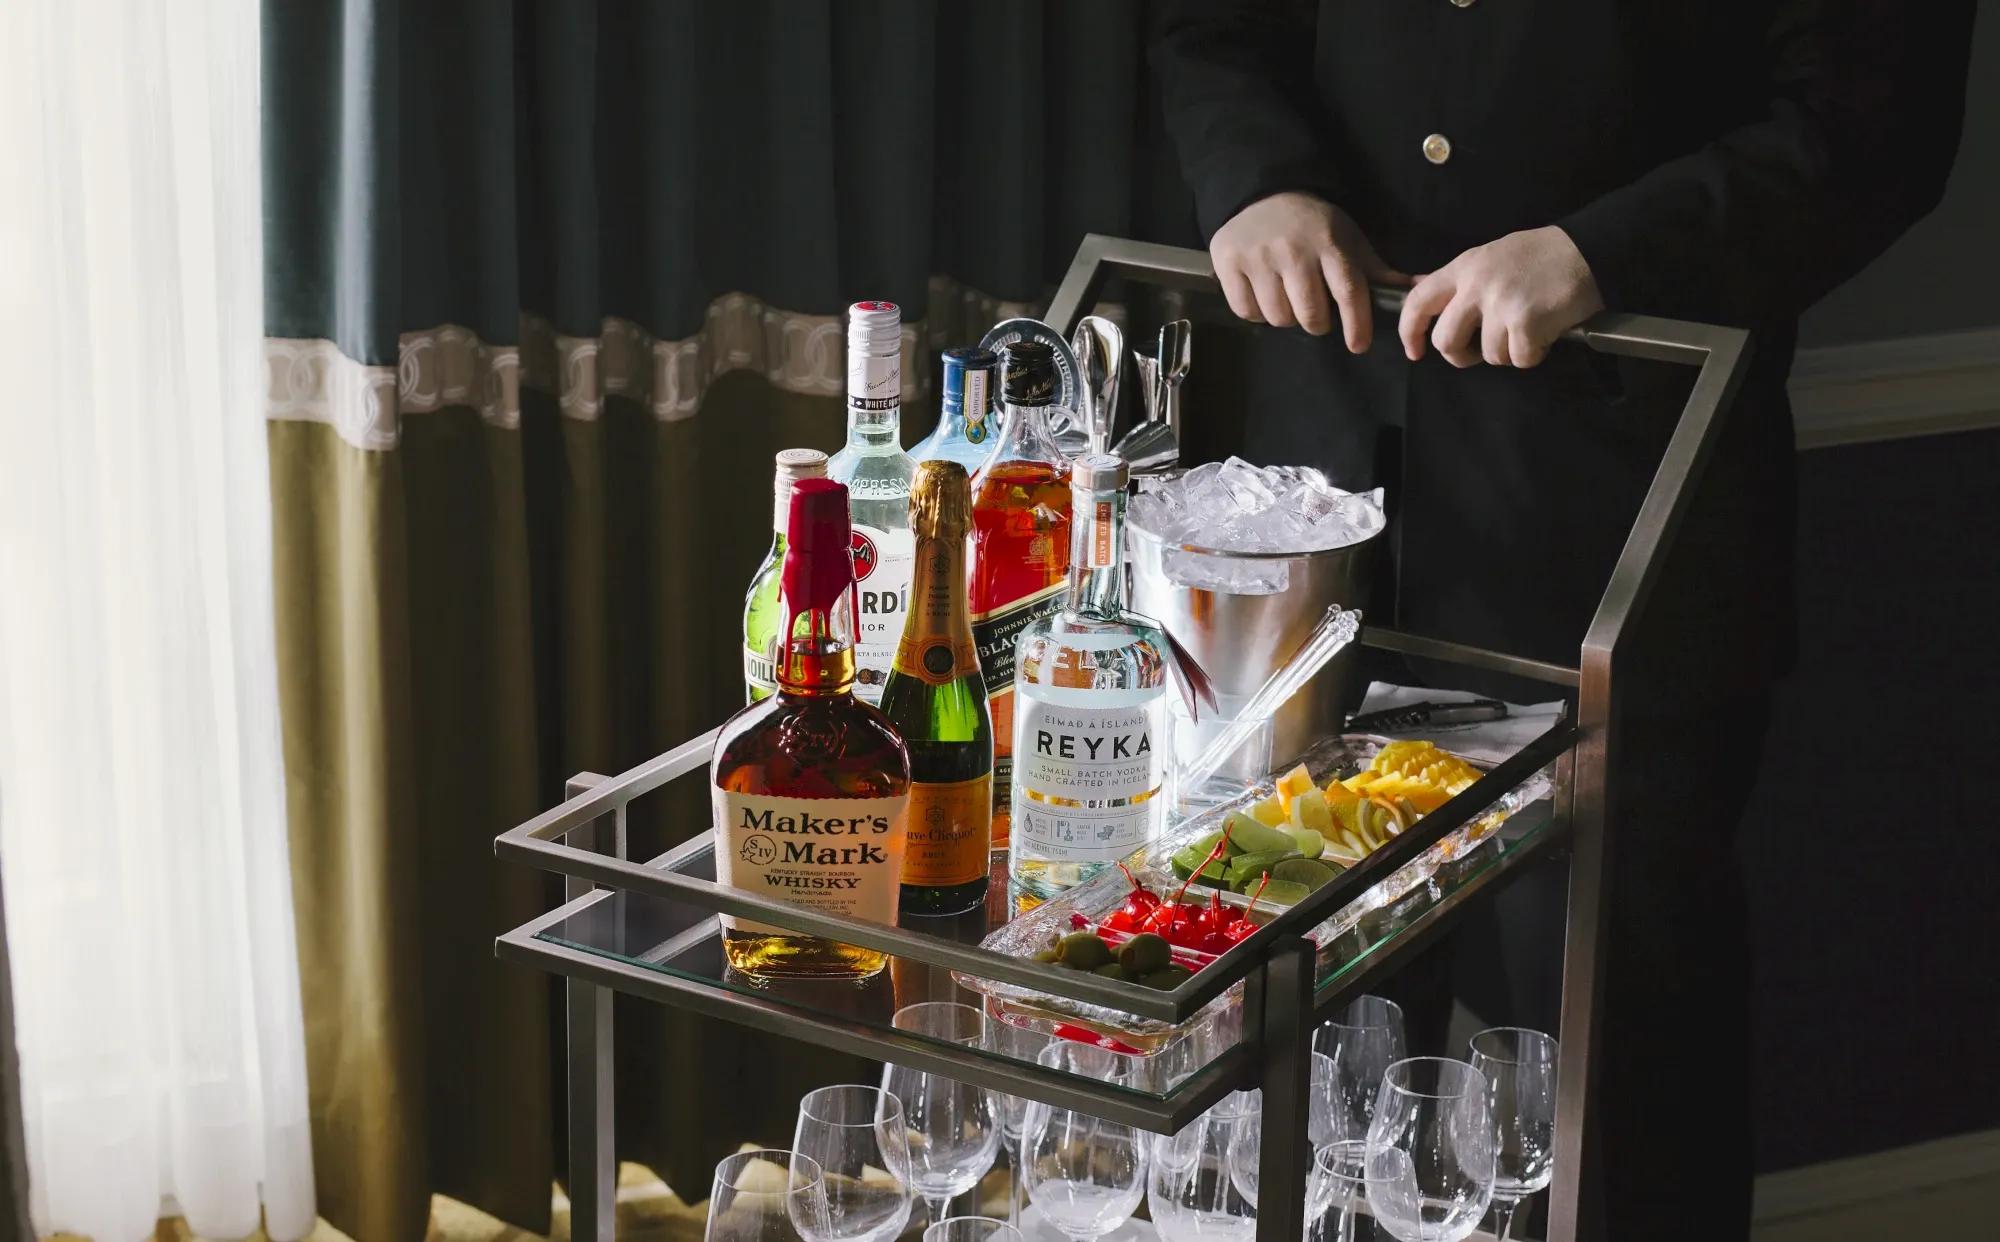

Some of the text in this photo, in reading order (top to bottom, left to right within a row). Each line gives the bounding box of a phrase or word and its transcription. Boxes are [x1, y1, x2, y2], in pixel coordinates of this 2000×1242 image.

[865, 398, 900, 409] WHITE RU
[849, 477, 912, 496] MPRESA
[862, 582, 909, 614] RDÍ
[861, 623, 886, 632] IOR
[993, 601, 1068, 638] JOHNNIE WALKER
[978, 632, 1022, 658] BLAC
[993, 654, 1016, 669] Blen
[1000, 667, 1015, 677] BLEN
[1037, 729, 1151, 760] REYKA
[1028, 769, 1051, 782] HAND
[1055, 777, 1103, 787] CRAFTED
[1123, 773, 1151, 785] ICELA
[1041, 765, 1147, 778] SMALL BATCH VODKA
[739, 806, 889, 836] Maker's
[907, 826, 974, 848] uve Clicquot
[750, 839, 772, 858] S IV
[780, 841, 886, 866] Mark
[764, 874, 862, 889] WHISKY
